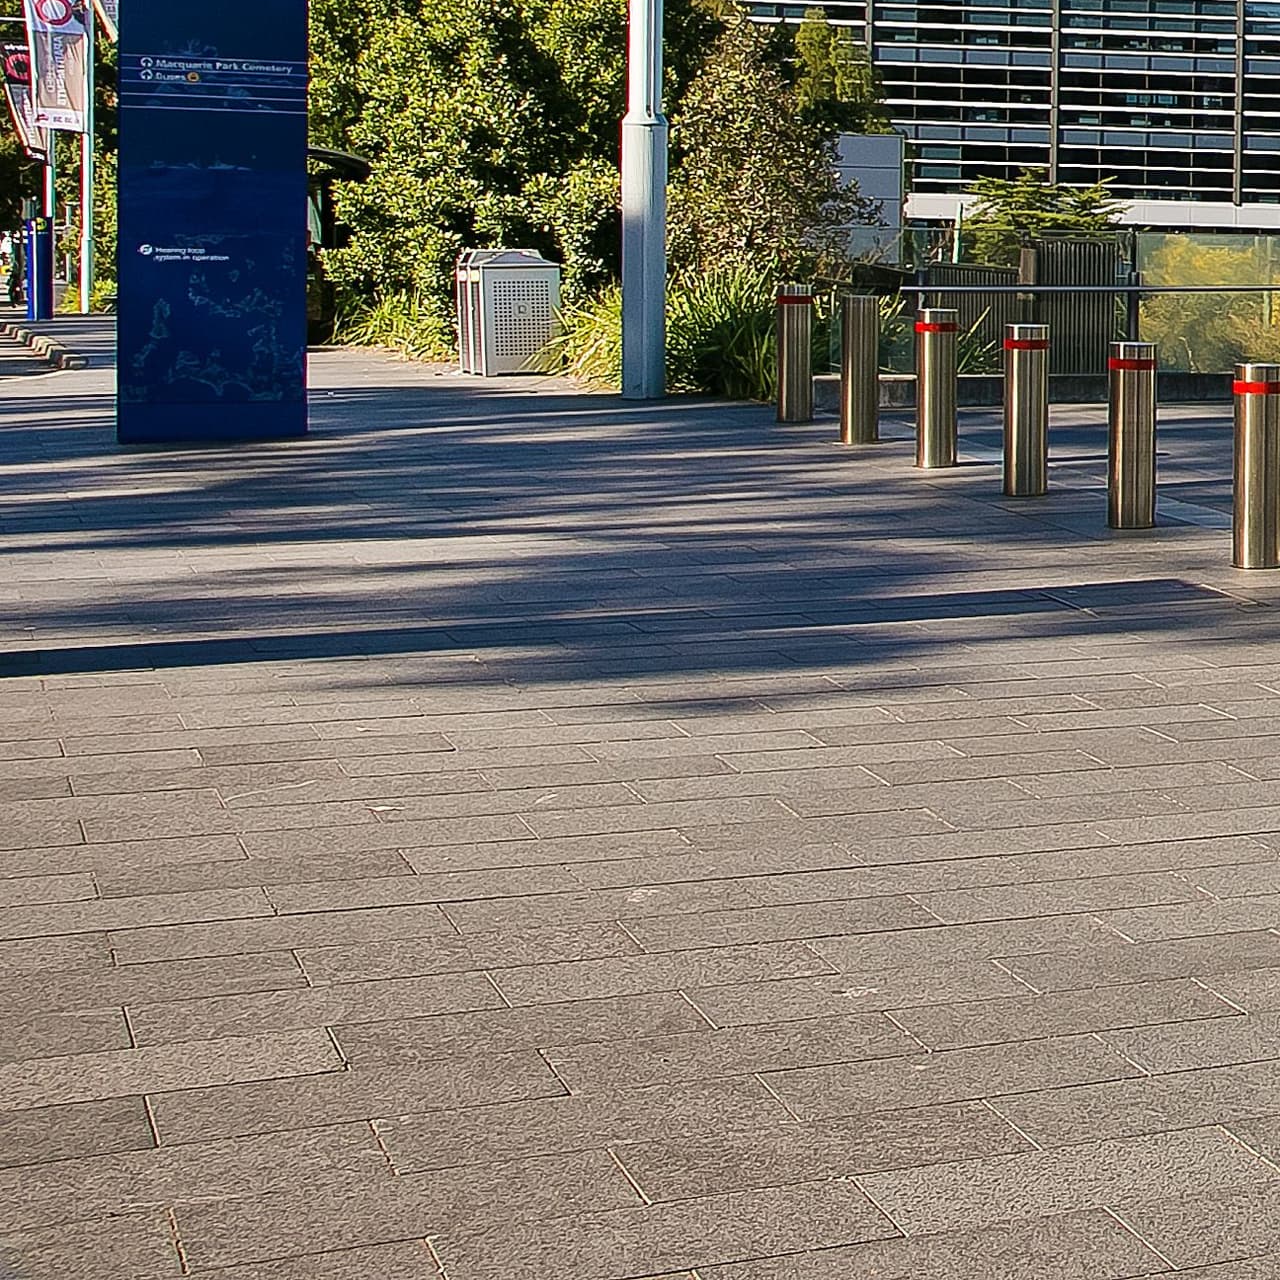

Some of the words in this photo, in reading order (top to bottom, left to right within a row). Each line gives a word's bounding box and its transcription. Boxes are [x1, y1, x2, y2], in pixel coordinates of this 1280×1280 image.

[155, 59, 213, 70] Macquarie
[215, 61, 239, 71] Park
[242, 63, 293, 75] Cemetery
